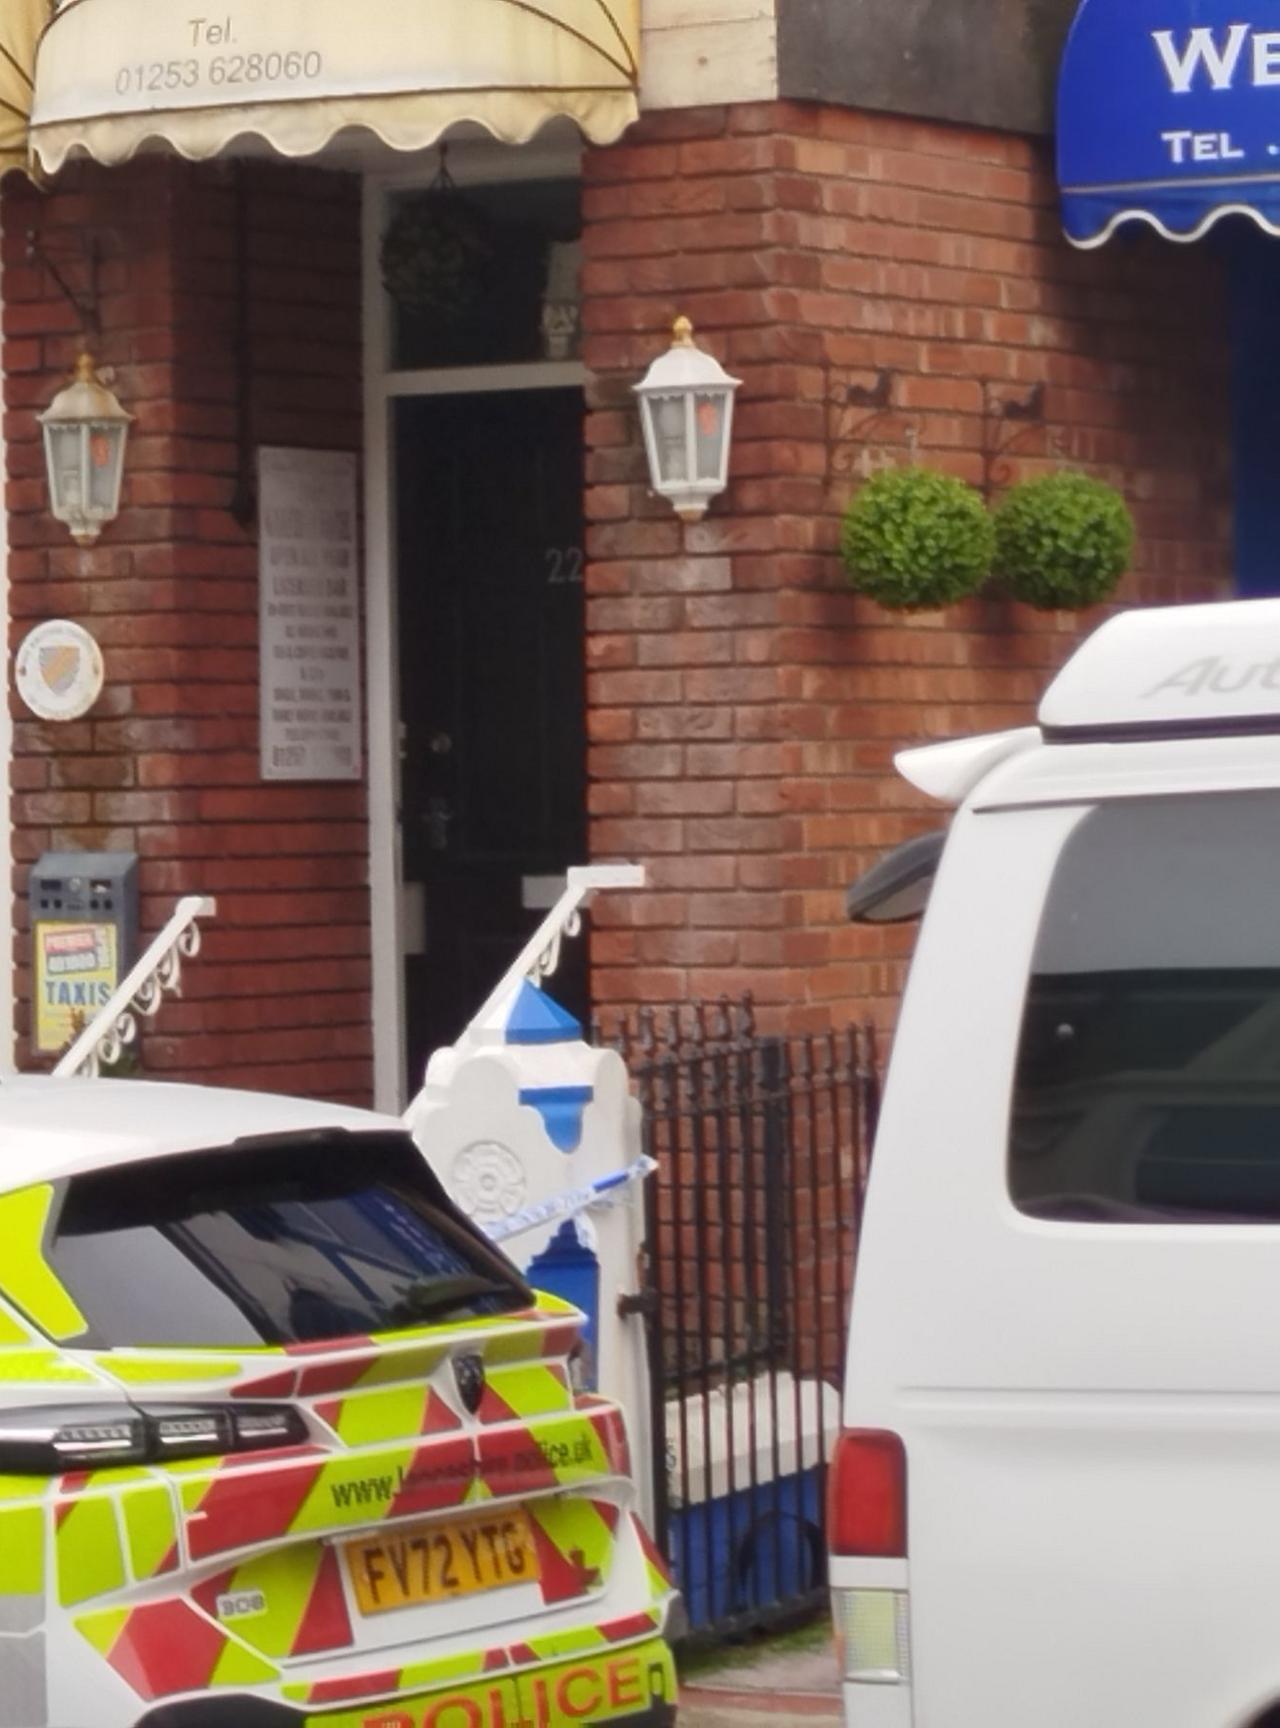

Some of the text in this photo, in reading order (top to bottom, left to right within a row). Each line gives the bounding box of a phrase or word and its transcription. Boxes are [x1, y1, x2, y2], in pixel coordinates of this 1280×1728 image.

[188, 16, 237, 46] Tel.
[115, 51, 322, 95] 01253 628060
[1160, 130, 1246, 164] TEL
[545, 547, 584, 582] 22
[45, 980, 111, 1007] TAXIS
[363, 1521, 527, 1603] FV72 YTG
